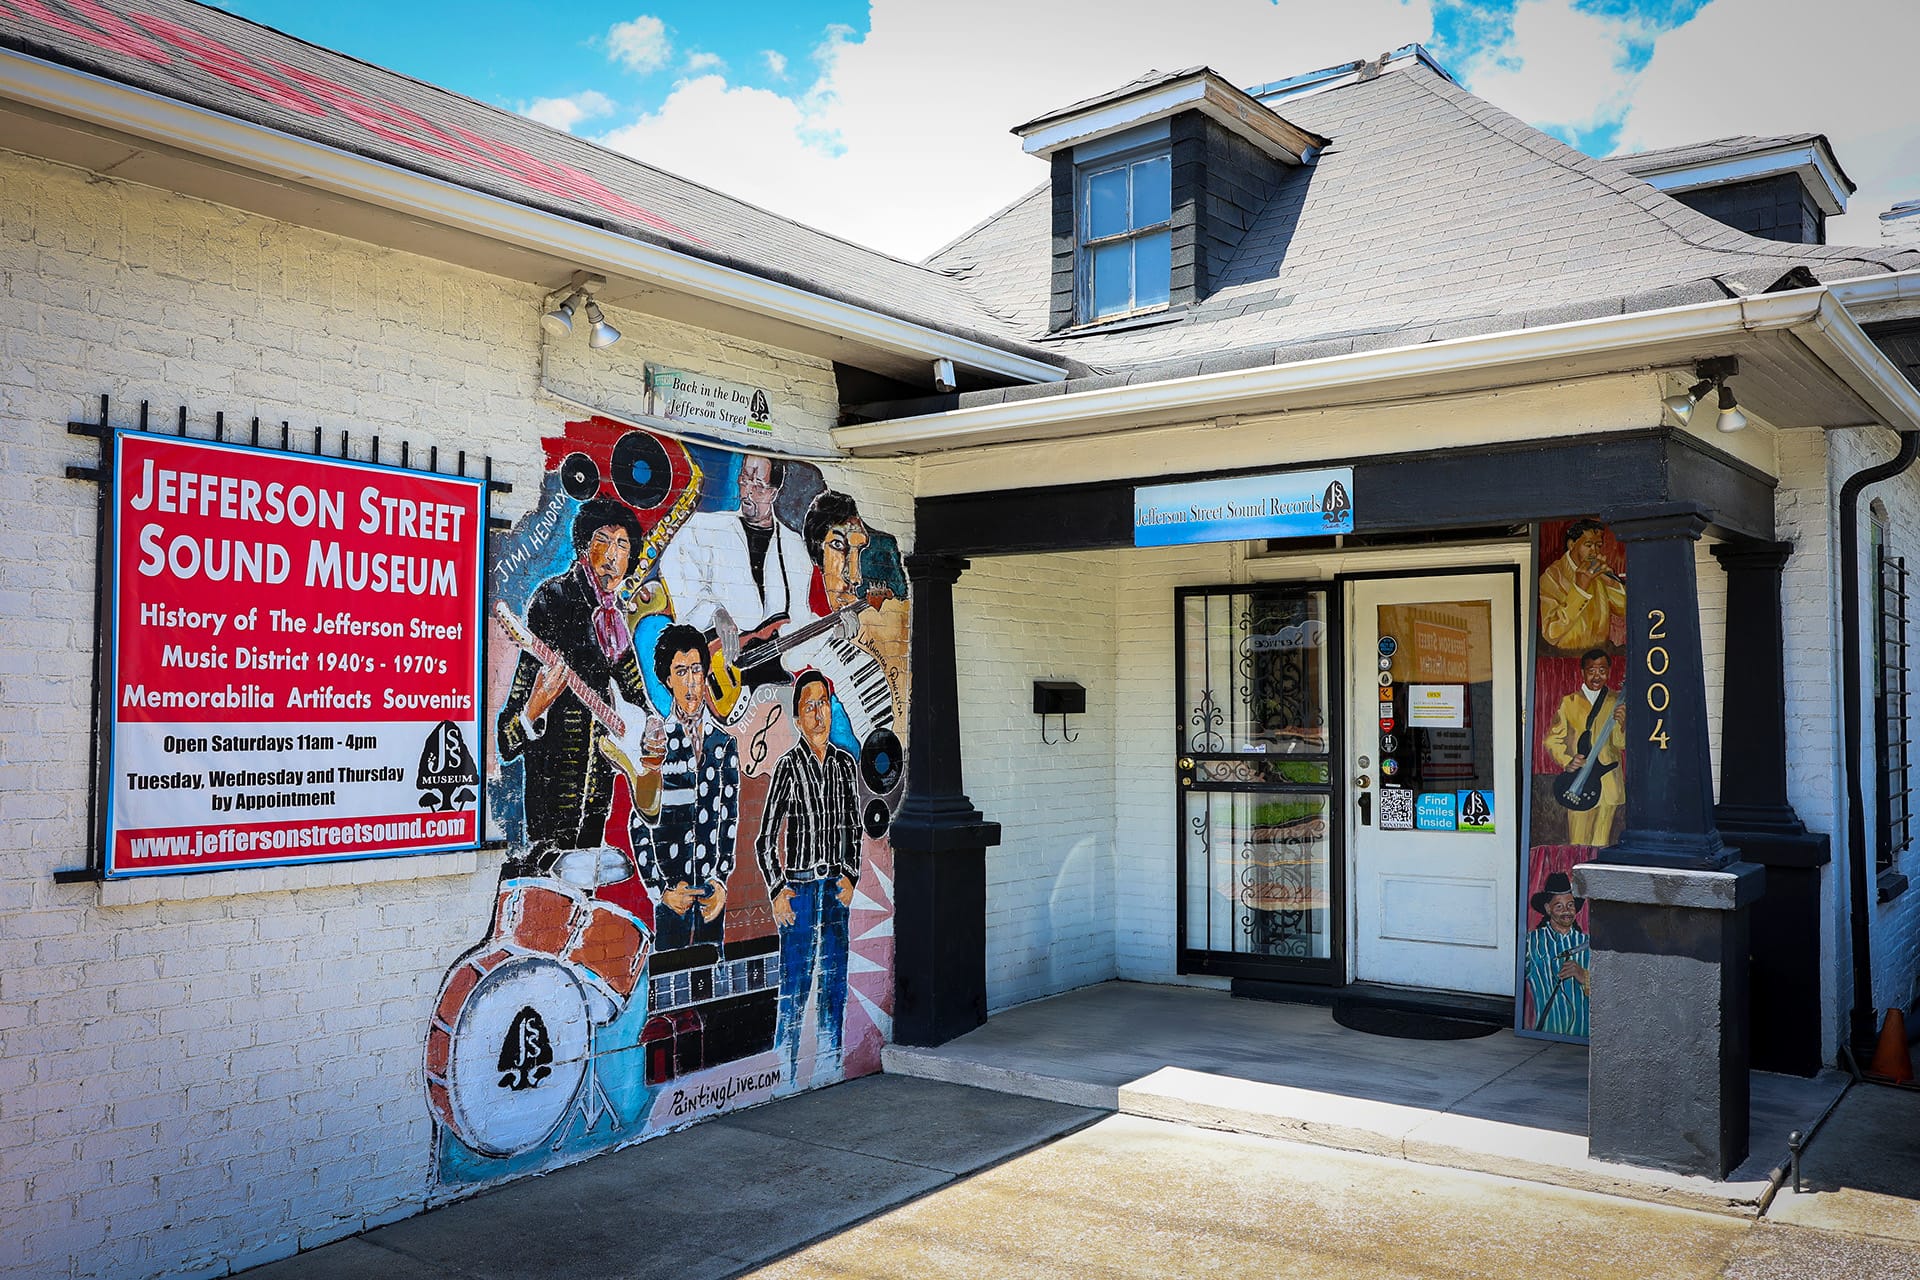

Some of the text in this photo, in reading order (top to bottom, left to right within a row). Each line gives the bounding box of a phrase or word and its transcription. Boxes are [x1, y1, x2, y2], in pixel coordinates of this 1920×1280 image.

[673, 377, 698, 394] Back
[700, 384, 711, 397] in
[714, 386, 729, 400] the
[731, 390, 751, 409] Day
[706, 400, 715, 408] on
[669, 399, 716, 419] Jefferson
[718, 409, 747, 425] Street
[130, 459, 466, 542] JEFFERSON STREET
[1135, 495, 1321, 527] Jefferson Street Sound Records
[494, 488, 569, 582] JIMI HENDRIX
[138, 523, 458, 597] SOUND MUSEUM
[140, 603, 462, 640] History of The Jefferson Street
[161, 645, 228, 669] Music
[235, 647, 309, 672] District
[317, 655, 375, 673] 1940's
[394, 656, 447, 675] 1970's
[1646, 609, 1670, 749] 2004
[122, 684, 471, 710] Memorabilia Artifacts Souvenirs
[738, 688, 778, 734] BILLY COX
[164, 735, 207, 754] Open
[211, 733, 294, 752] Saturdays
[297, 735, 334, 751] 11am
[346, 734, 377, 751] 4pm
[127, 766, 404, 791] Tuesday, Wednesday and Thursday
[422, 775, 473, 785] MUSEUM
[212, 790, 336, 812] by Appointment
[1418, 806, 1454, 817] Smiles
[1425, 795, 1448, 806] Find
[1420, 818, 1452, 828] Inside
[130, 816, 466, 859] www.jeffersonstreetsound.com
